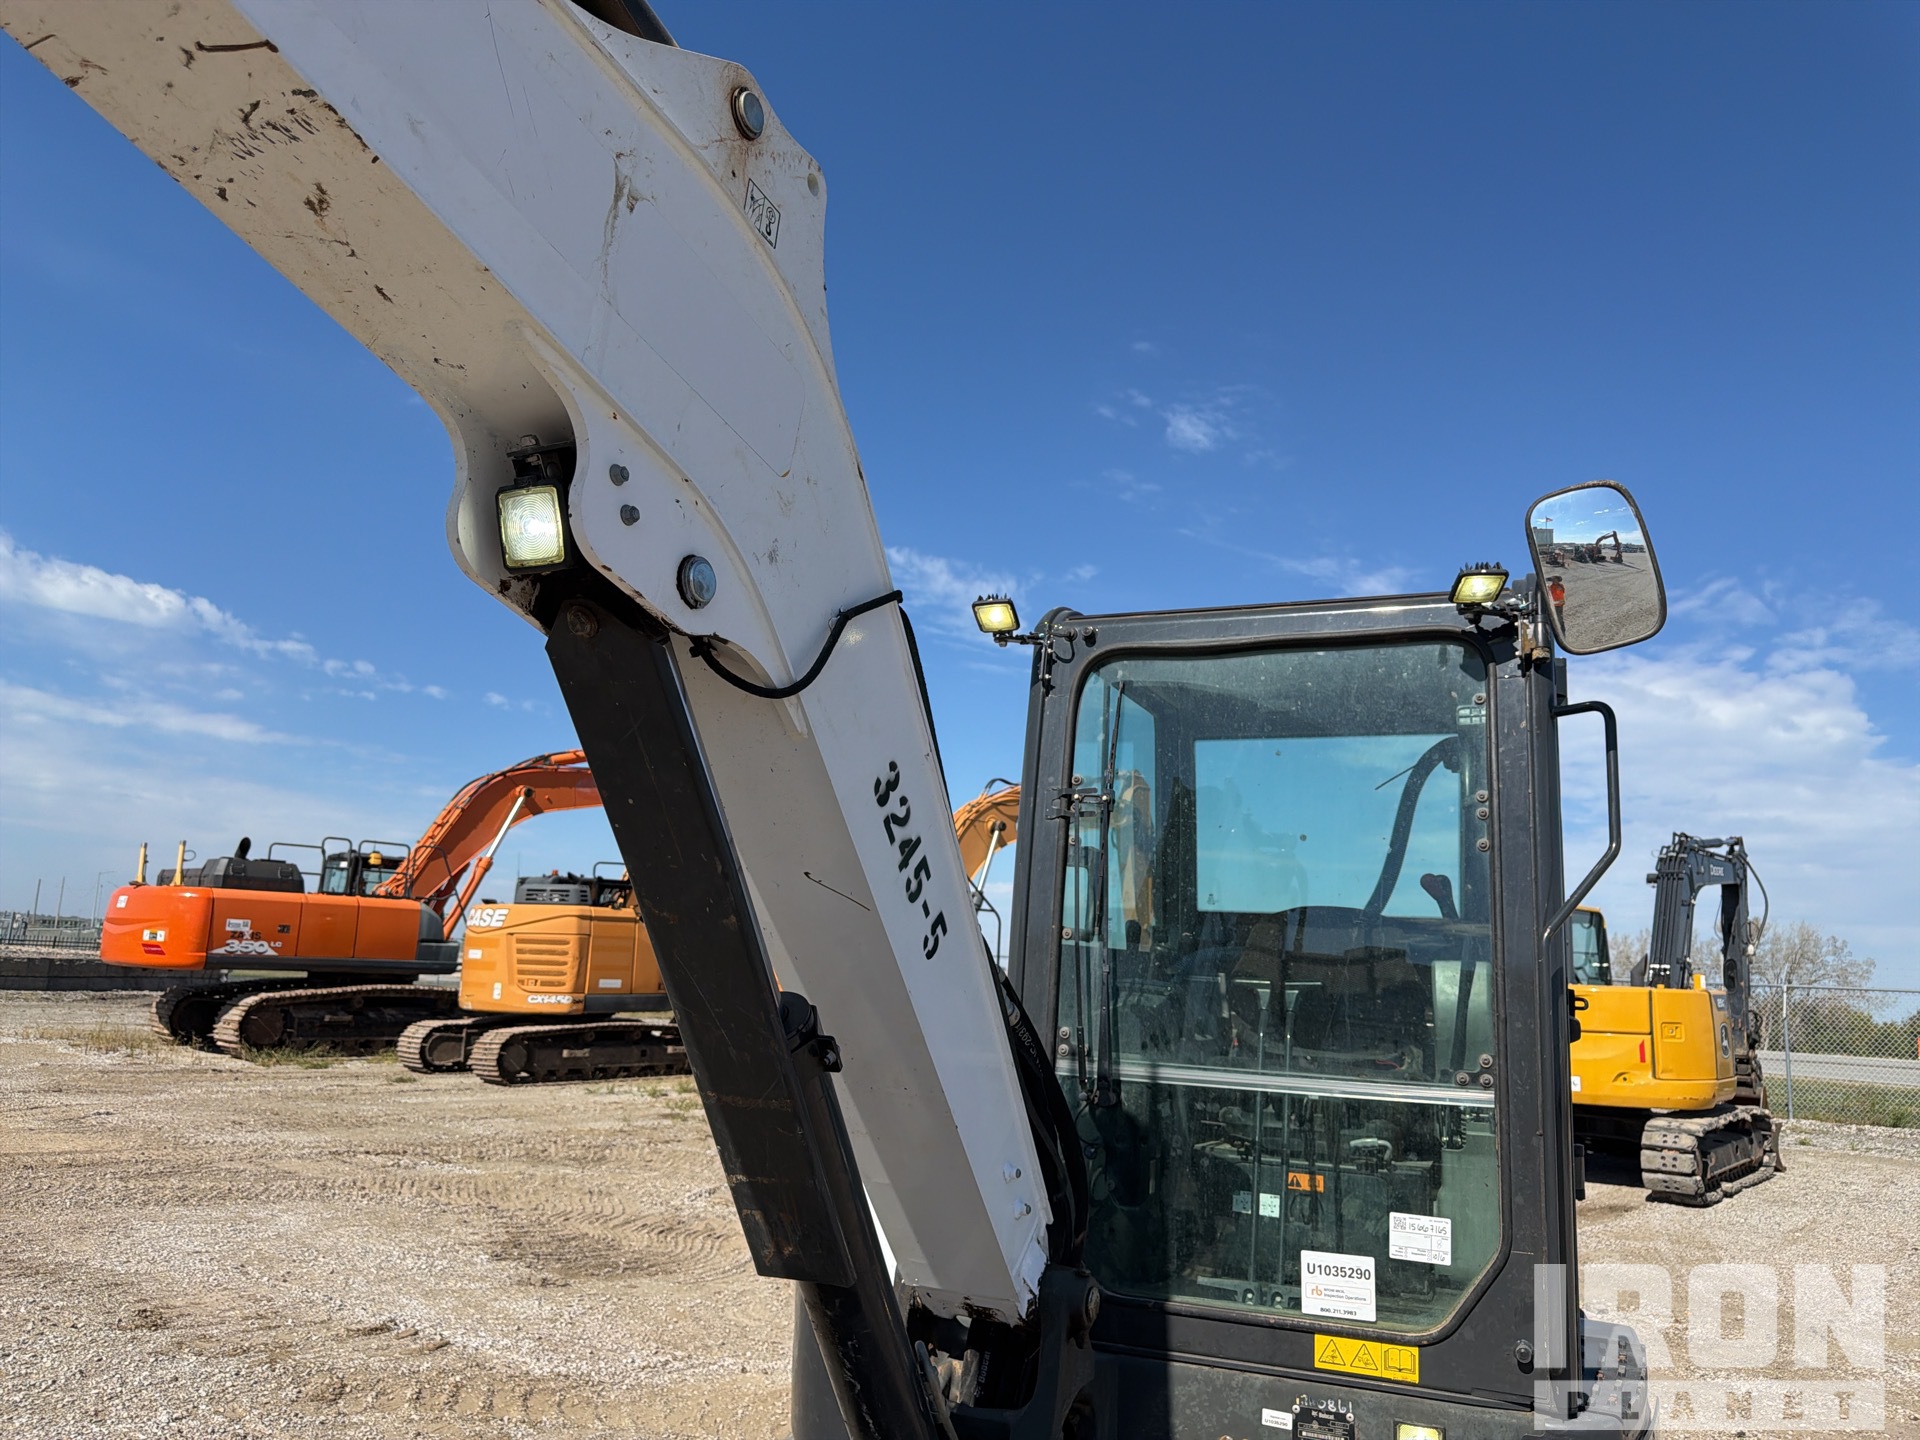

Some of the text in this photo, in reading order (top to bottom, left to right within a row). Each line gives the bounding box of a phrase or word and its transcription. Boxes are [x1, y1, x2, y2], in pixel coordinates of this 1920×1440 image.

[874, 760, 948, 960] 3245-5
[225, 939, 268, 954] 350
[1306, 1262, 1371, 1281] U1035290
[1311, 1285, 1323, 1297] rb
